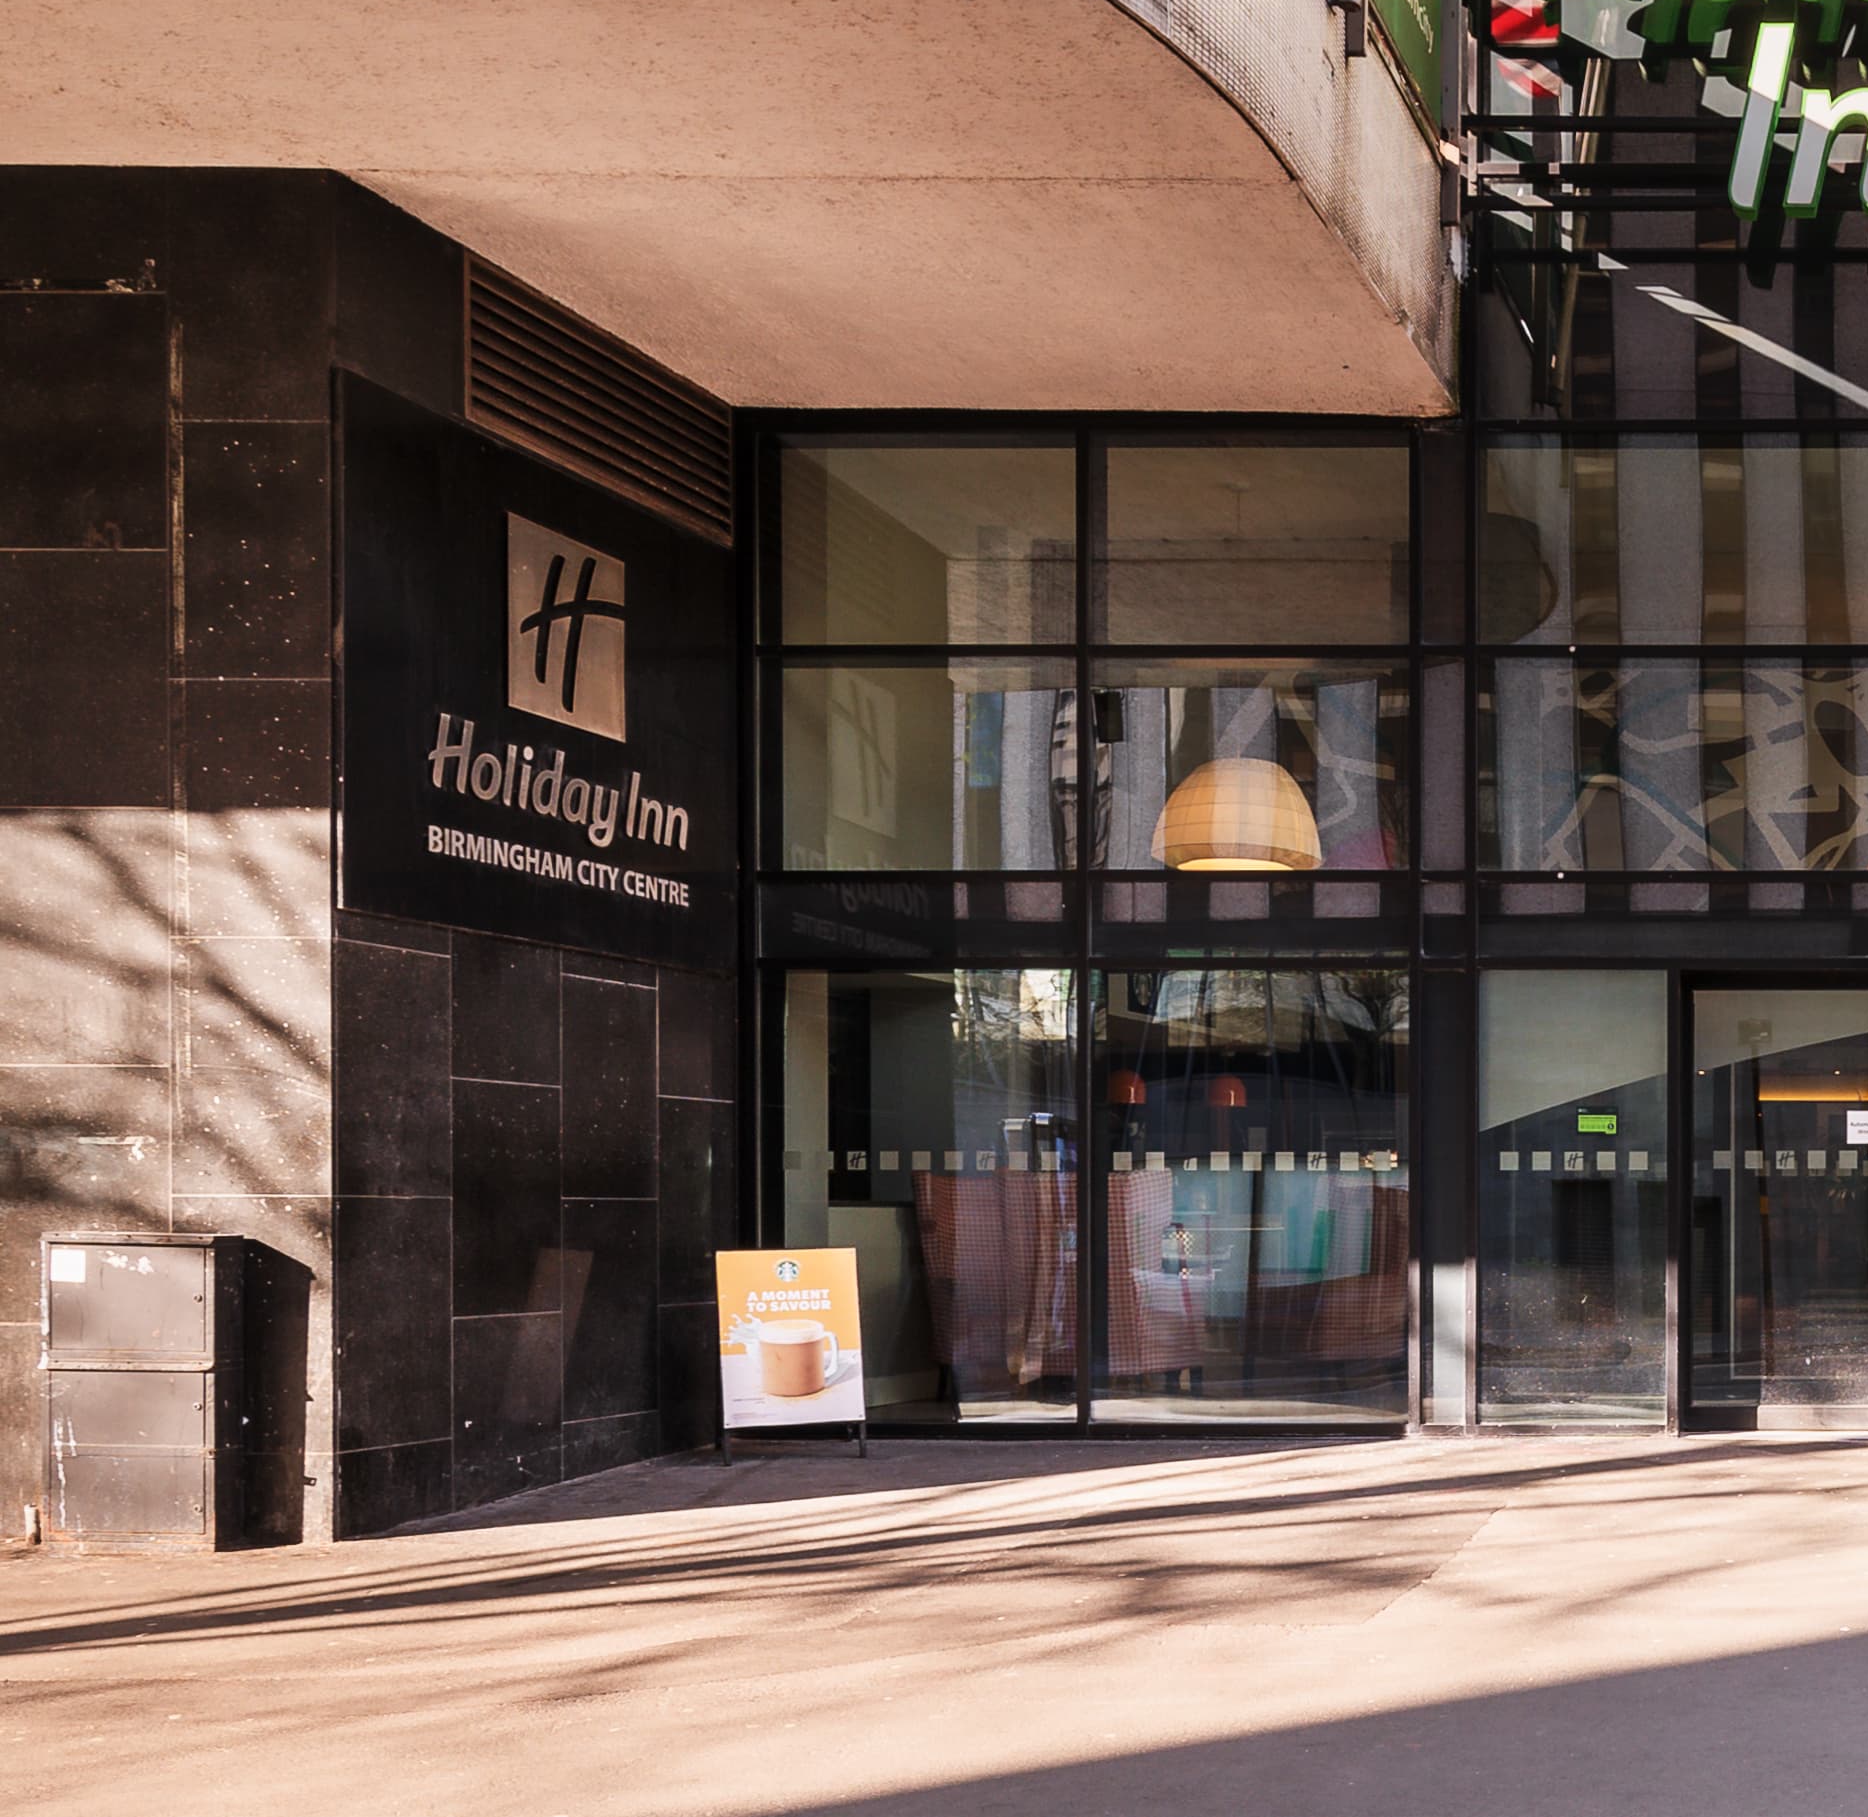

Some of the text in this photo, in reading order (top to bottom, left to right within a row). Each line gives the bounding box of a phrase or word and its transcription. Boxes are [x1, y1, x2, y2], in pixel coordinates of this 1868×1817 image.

[427, 712, 689, 851] Holiday Inn
[427, 824, 690, 908] BIRMINGHAM CITY CENTRE
[747, 1288, 830, 1302] A MOMENT
[747, 1299, 832, 1313] TO SAVOUR
